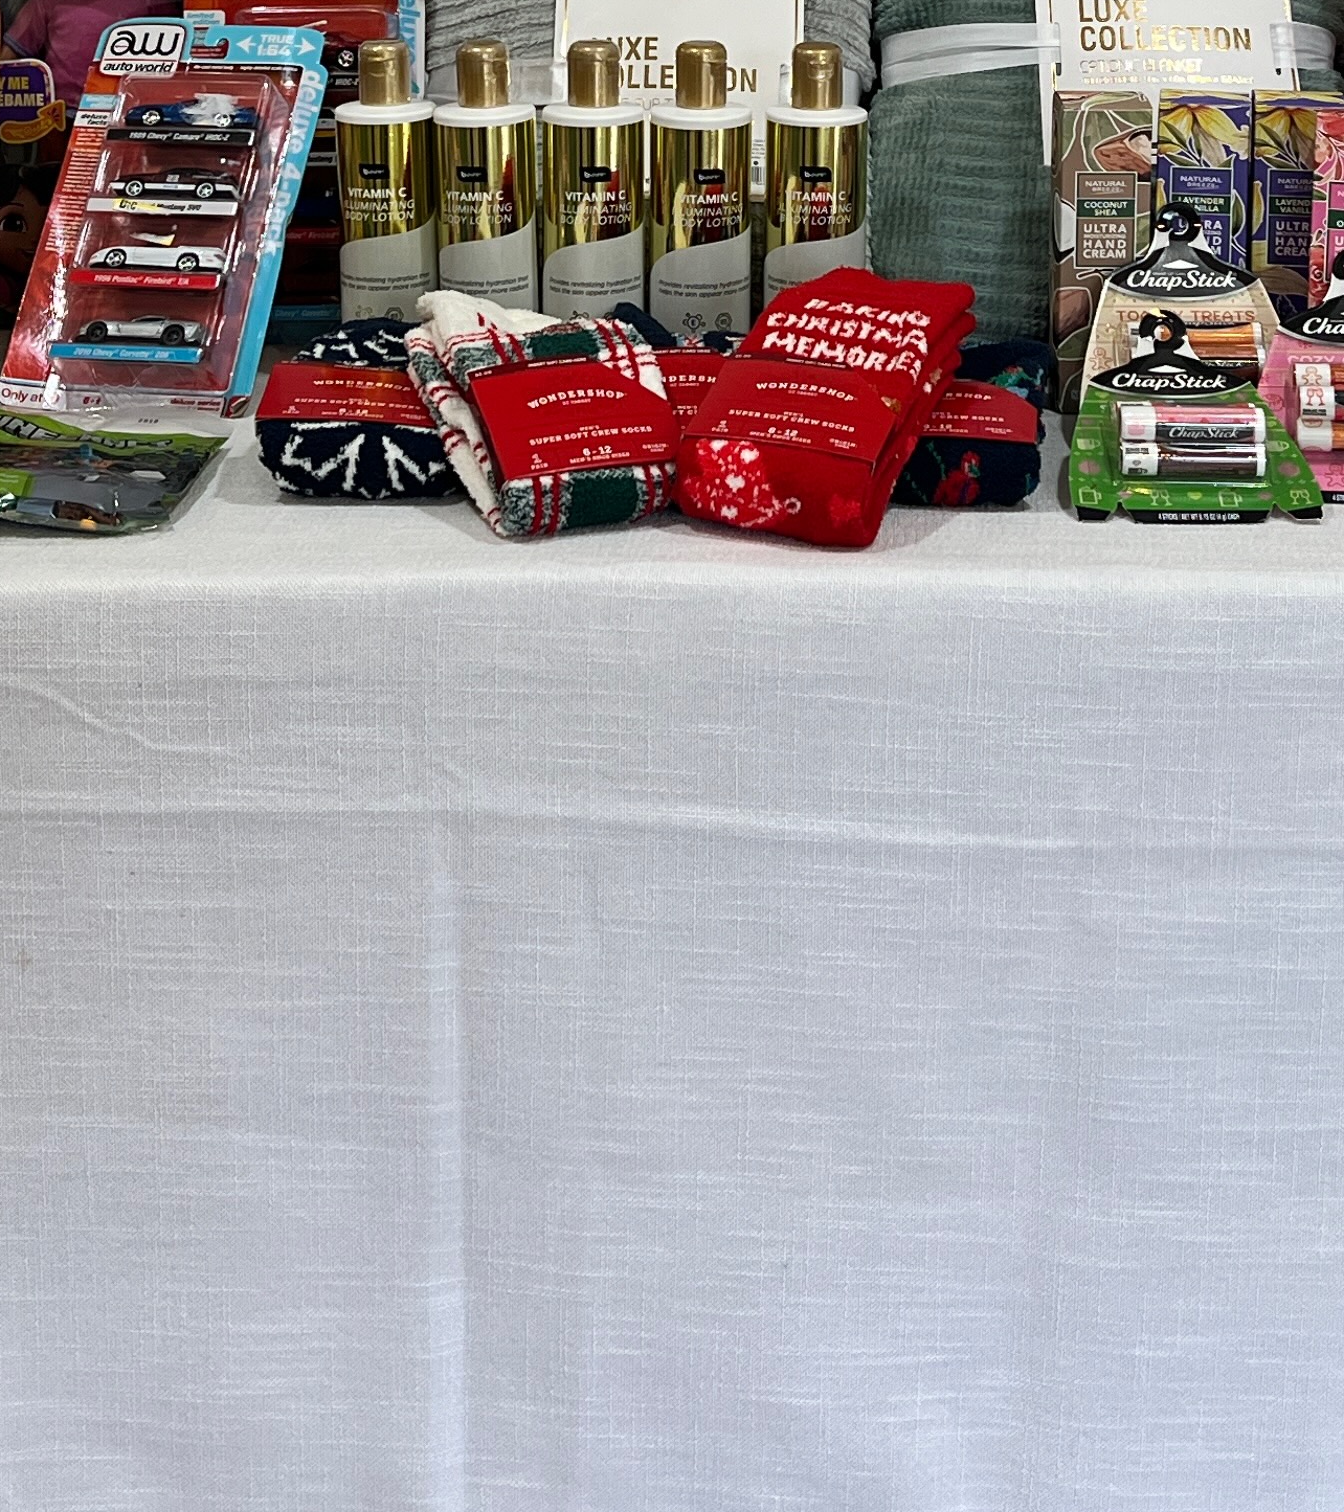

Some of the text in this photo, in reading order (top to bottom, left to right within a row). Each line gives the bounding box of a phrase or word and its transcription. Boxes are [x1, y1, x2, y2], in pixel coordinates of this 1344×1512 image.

[261, 34, 296, 45] TRUE
[1080, 25, 1252, 53] COLLECTION
[258, 43, 291, 57] 1:64
[103, 61, 175, 73] auto world
[7, 76, 30, 90] ME
[287, 70, 322, 155] deluxe
[1085, 179, 1127, 188] NATURAL
[1179, 175, 1223, 184] NATURAL
[347, 187, 407, 199] VITAMIN C
[446, 190, 504, 202] VITAMIN C
[564, 190, 627, 201] VITAMIN C
[731, 191, 739, 202] C
[838, 190, 846, 201] C
[344, 199, 415, 210] ILLUMINATING
[1084, 200, 1129, 210] COCONUT
[1178, 196, 1226, 206] LAVENDER
[443, 202, 513, 213] ILLUMINATING
[559, 202, 632, 214] ILLUMINATING
[1094, 208, 1119, 217] SHEA
[372, 210, 415, 222] LOTION
[469, 213, 512, 225] LOTION
[590, 213, 631, 225] LOTION
[706, 215, 742, 227] LOTION
[811, 213, 851, 225] LOTION
[1083, 222, 1128, 235] ULTRA
[1083, 239, 1128, 250] HAND
[1083, 248, 1127, 259] CREAM
[1126, 270, 1236, 291] ChapStick
[1112, 374, 1227, 390] ChapStick
[2, 388, 42, 404] Only at
[756, 382, 854, 402] WONDERSHOP
[527, 388, 625, 409] WONDERSHOP
[728, 409, 855, 433] SUPER SOFT CREW SOCKS
[529, 425, 653, 447] SUPER SOFT CREW SOCKS
[1169, 427, 1239, 439] ChapStick
